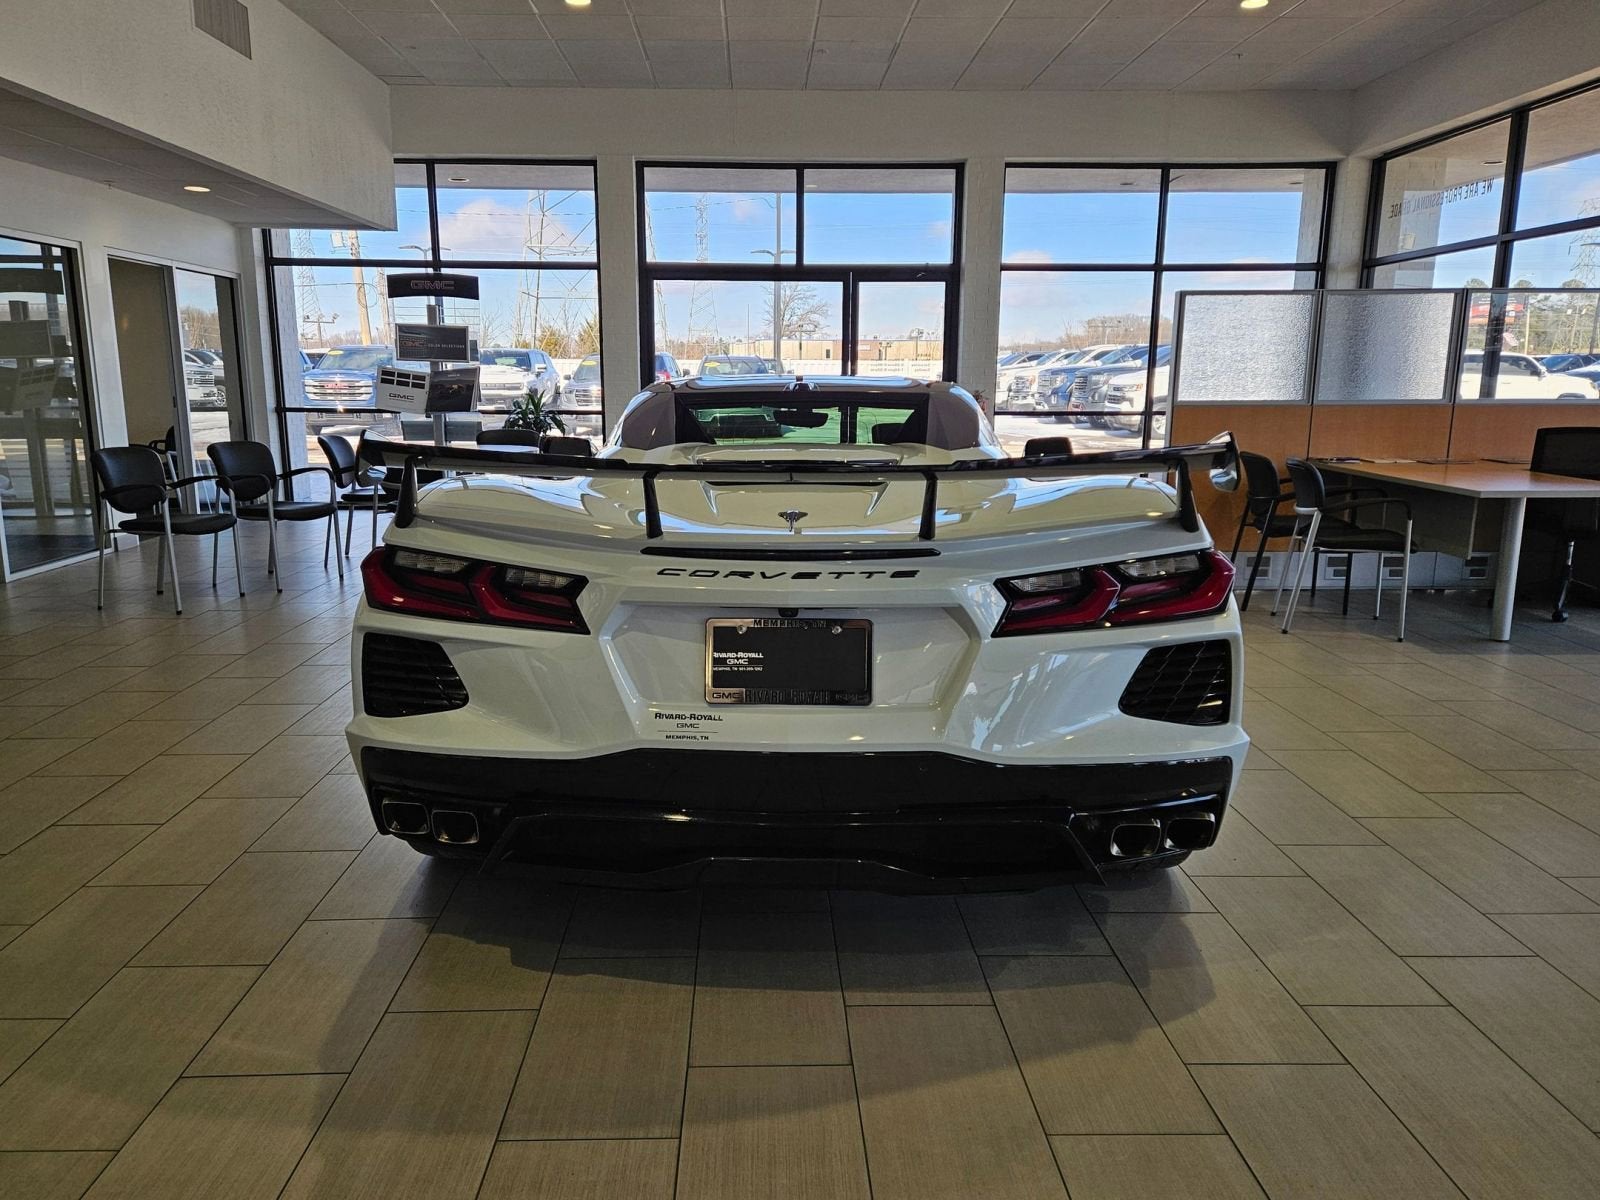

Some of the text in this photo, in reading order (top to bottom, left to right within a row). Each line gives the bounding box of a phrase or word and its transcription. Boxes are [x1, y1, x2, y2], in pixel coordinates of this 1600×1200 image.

[411, 280, 454, 290] GMC
[388, 392, 415, 400] GMC
[656, 568, 920, 580] CORVETTE
[711, 691, 741, 700] GMC
[654, 712, 723, 721] RIVARD-ROYALL
